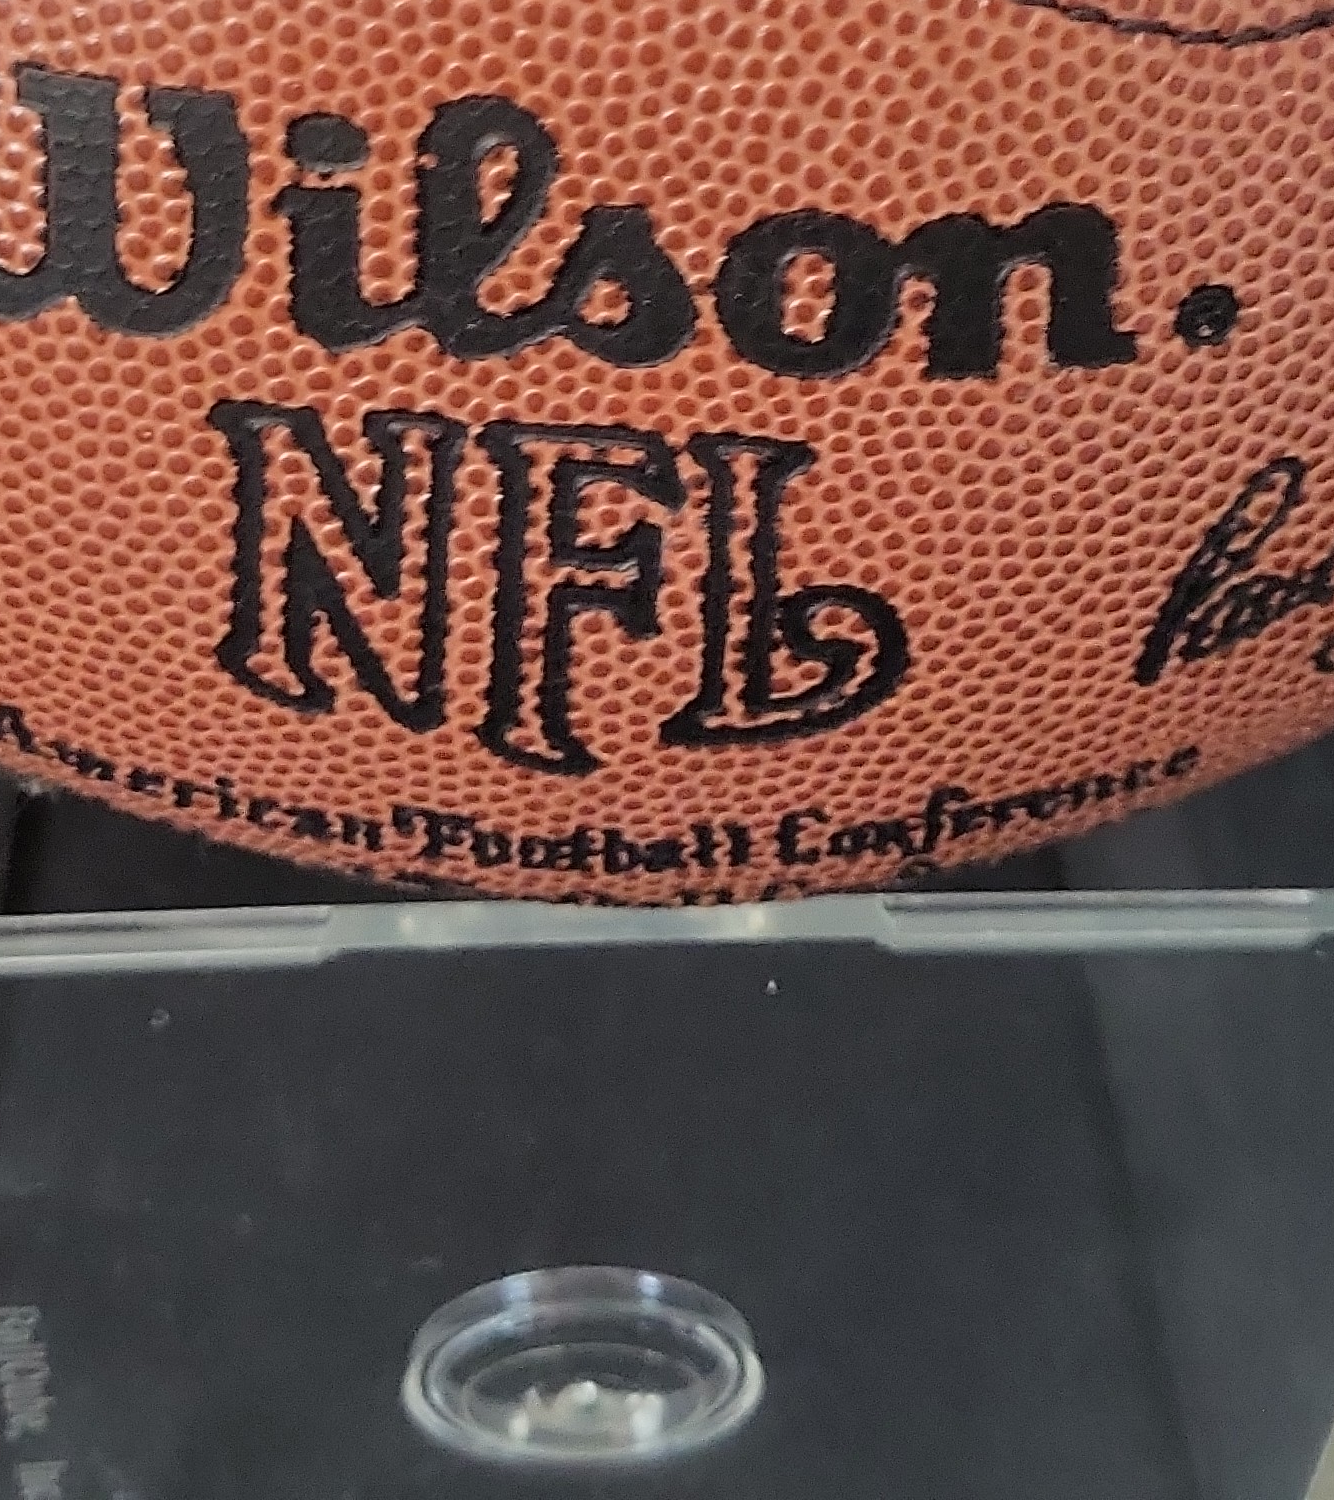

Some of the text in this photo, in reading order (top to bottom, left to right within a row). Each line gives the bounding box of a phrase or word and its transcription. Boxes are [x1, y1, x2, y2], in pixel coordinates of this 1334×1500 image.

[205, 397, 910, 777] NFL
[389, 804, 751, 874] Football
[774, 745, 1201, 866] Conference
